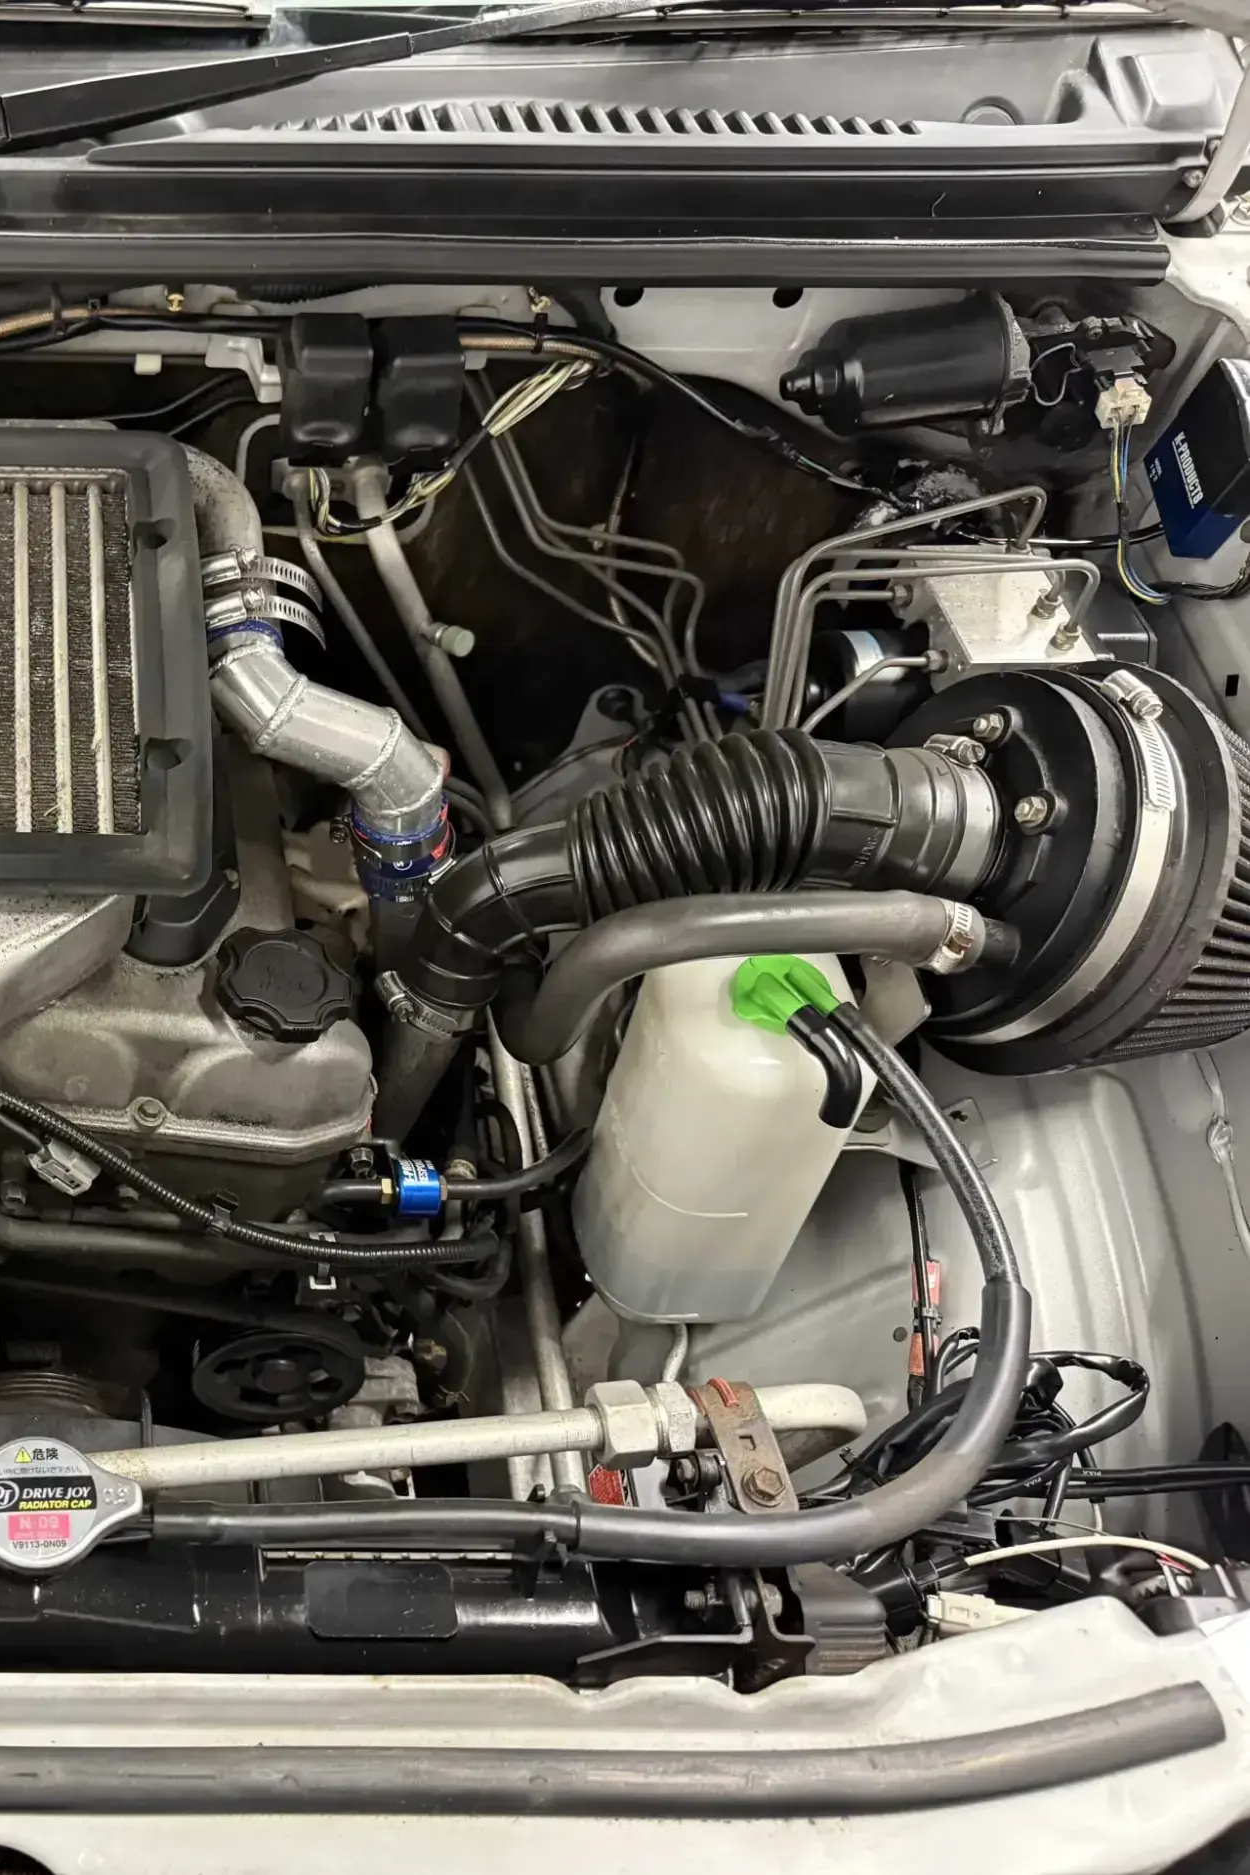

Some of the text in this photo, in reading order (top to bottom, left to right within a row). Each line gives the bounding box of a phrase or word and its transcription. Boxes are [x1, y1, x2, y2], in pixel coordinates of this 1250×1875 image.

[1174, 431, 1204, 505] K-PRODUCTS
[32, 1448, 60, 1461] 危険
[21, 1486, 92, 1500] DRIVE JOY
[18, 1499, 93, 1510] RADIATOR CAP
[12, 1540, 67, 1549] V9113-0N09
